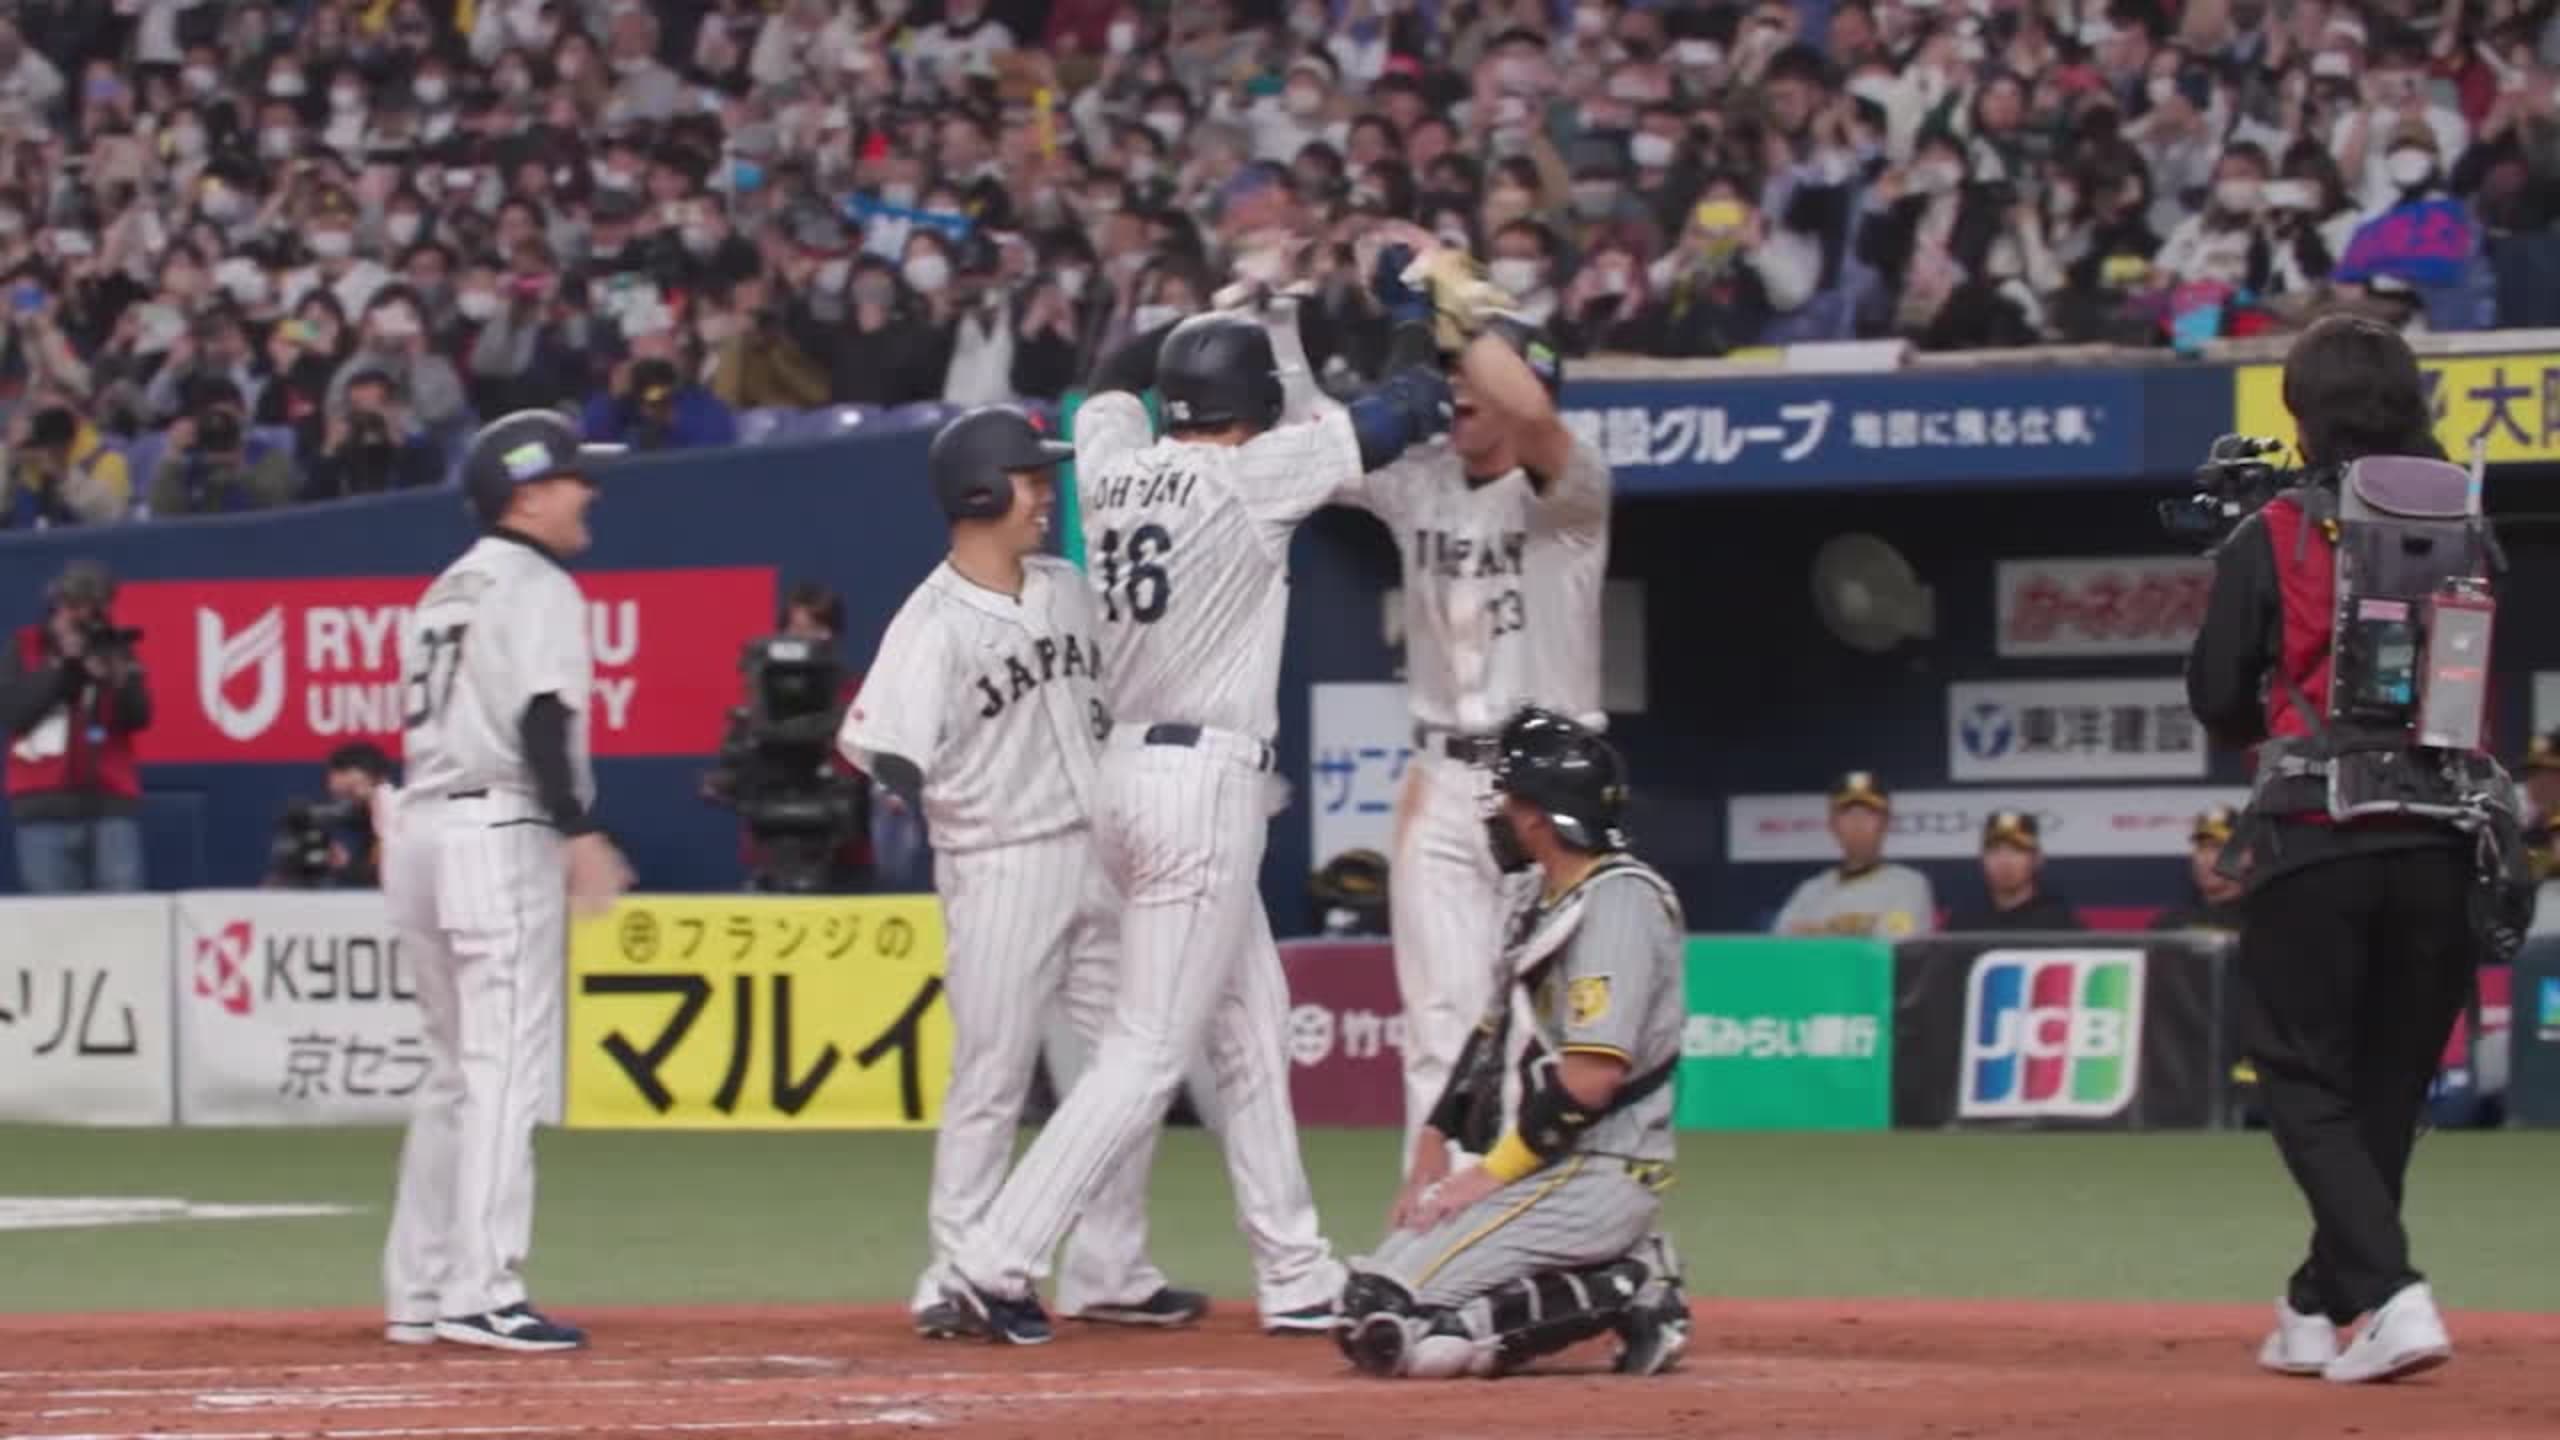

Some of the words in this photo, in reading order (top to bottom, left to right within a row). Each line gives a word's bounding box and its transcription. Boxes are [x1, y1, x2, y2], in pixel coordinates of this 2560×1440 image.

[1101, 524, 1172, 625] 16
[0, 967, 139, 1057] リム
[580, 971, 943, 1123] マルイ
[1973, 1007, 2129, 1058] JCB
